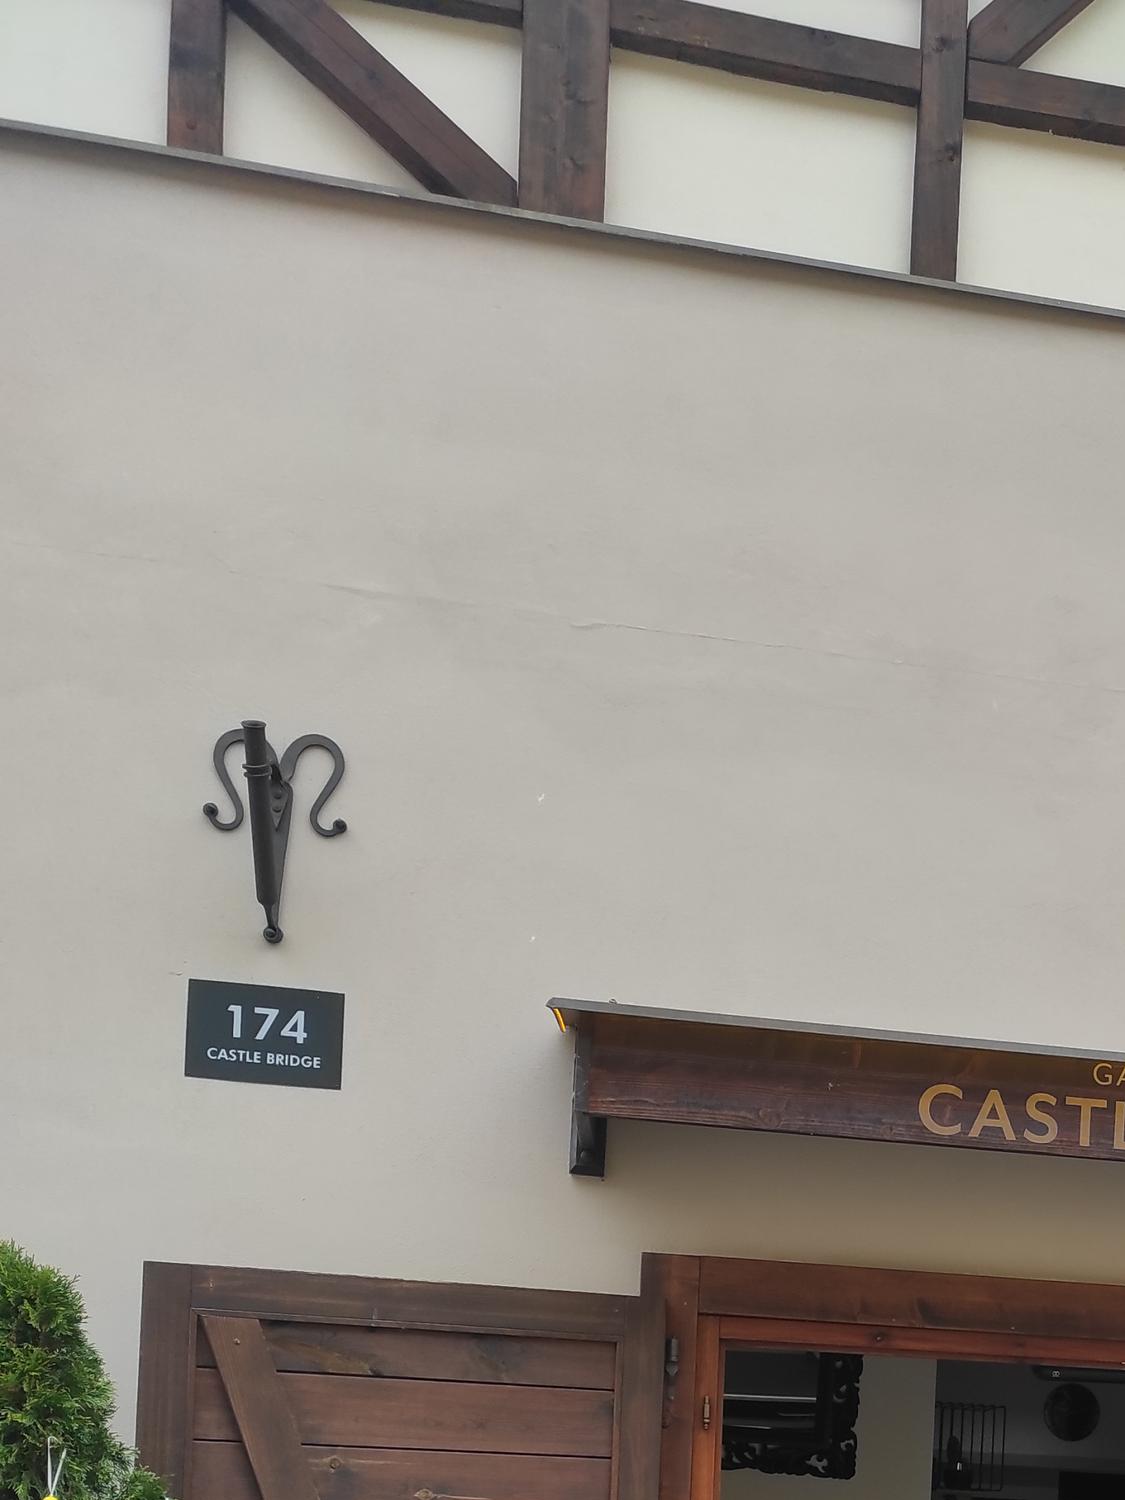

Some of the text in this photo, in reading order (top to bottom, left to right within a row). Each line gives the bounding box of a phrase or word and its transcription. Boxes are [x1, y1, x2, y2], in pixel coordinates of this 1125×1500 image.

[227, 1005, 308, 1044] 174
[206, 1047, 321, 1069] CASTLE BRIDGE
